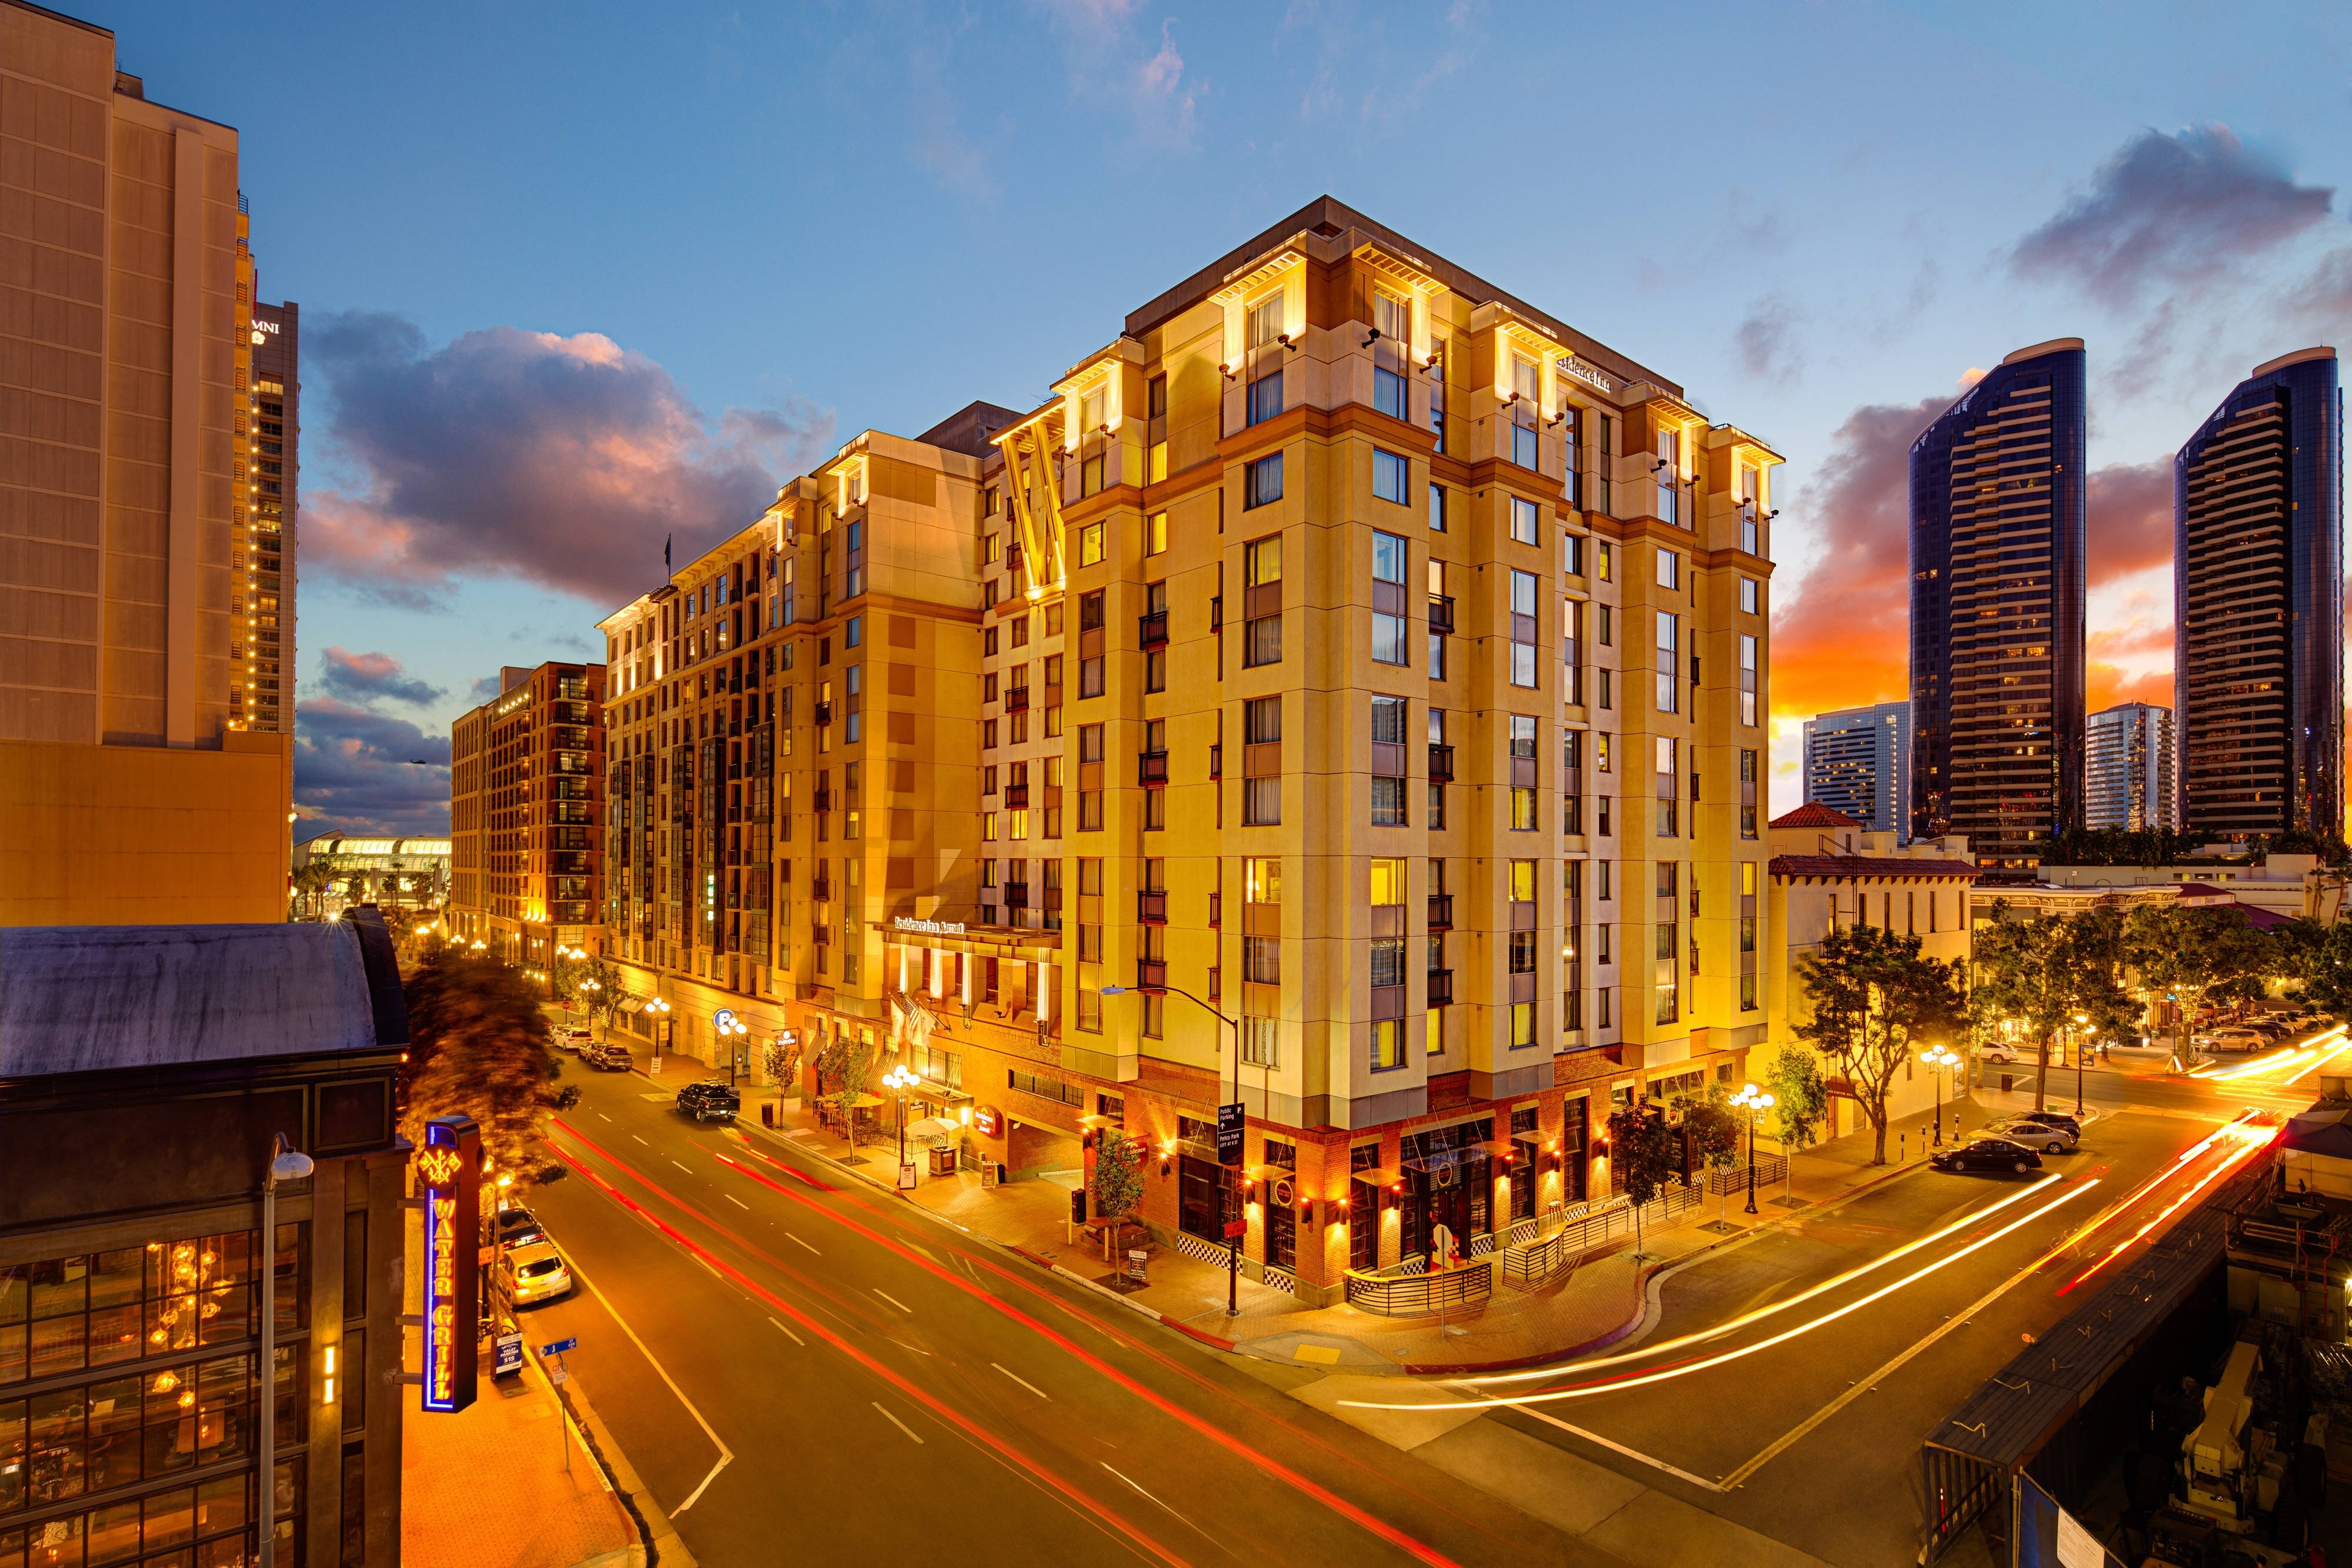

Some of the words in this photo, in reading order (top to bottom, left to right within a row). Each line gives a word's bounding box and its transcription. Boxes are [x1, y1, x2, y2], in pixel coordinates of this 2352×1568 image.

[252, 319, 279, 335] MNI
[1557, 356, 1595, 384] esidence
[1593, 371, 1611, 392] Inn
[894, 916, 926, 932] Residence
[926, 919, 940, 933] Inn
[719, 1012, 730, 1026] P
[433, 1199, 456, 1296] WATER
[432, 1305, 454, 1400] GRILL
[500, 1349, 519, 1358] PARKING
[504, 1355, 515, 1363] $15
